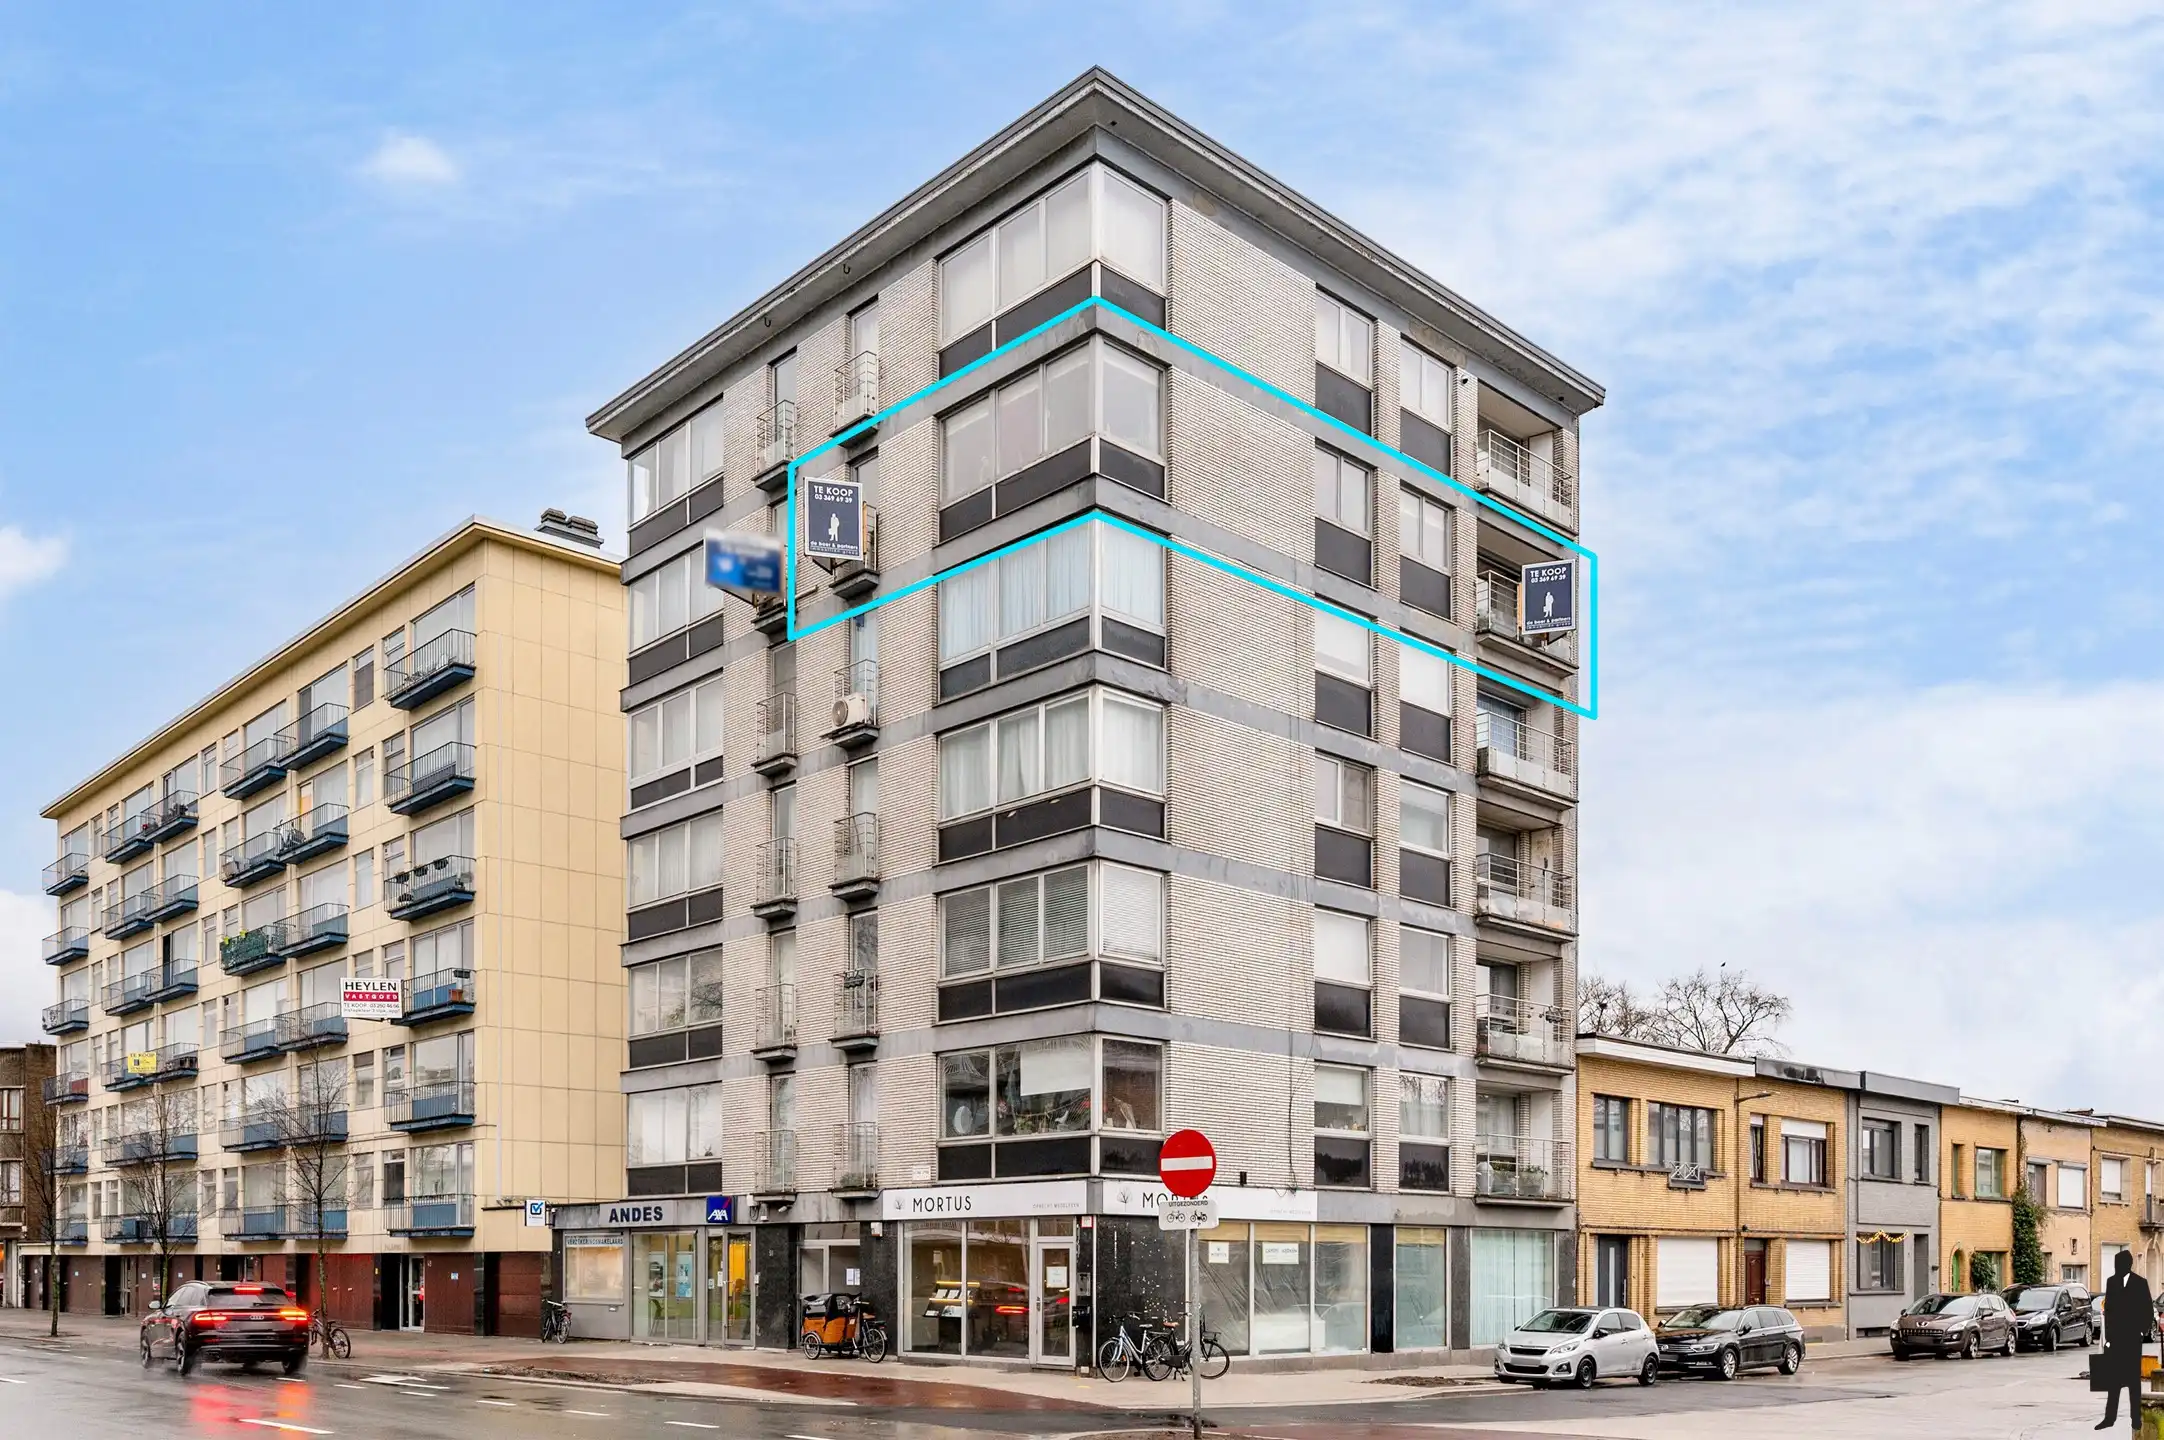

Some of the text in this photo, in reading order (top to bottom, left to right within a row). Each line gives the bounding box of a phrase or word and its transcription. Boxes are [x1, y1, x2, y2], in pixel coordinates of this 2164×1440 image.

[814, 485, 854, 497] TE KOOP
[1530, 567, 1567, 578] TE KOOP
[345, 981, 397, 991] HEYLEN
[912, 1195, 972, 1213] MORTUS
[609, 1206, 663, 1223] ANDES
[707, 1209, 728, 1220] AXA
